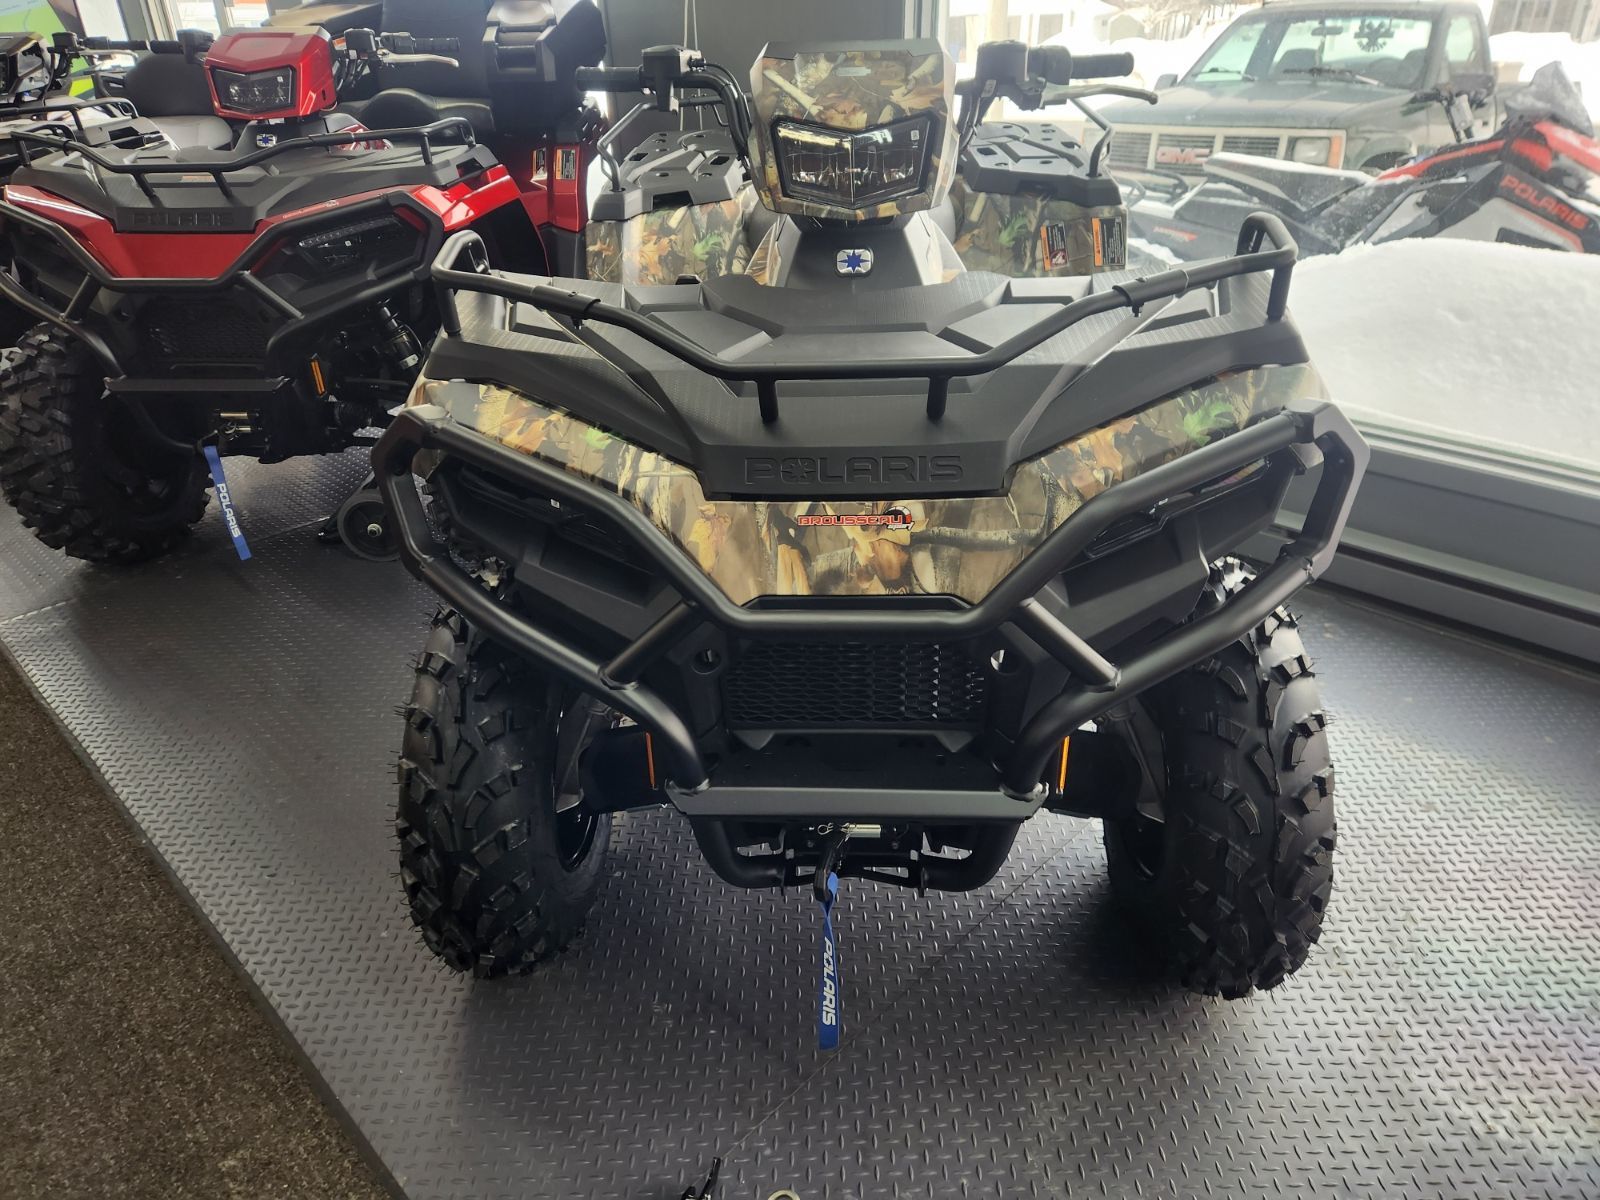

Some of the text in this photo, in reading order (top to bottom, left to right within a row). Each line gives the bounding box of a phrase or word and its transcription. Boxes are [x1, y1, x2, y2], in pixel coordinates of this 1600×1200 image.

[1156, 146, 1210, 165] GMC
[1500, 175, 1589, 230] POLARIS
[744, 456, 964, 484] POLARIS
[217, 483, 242, 538] POLARIS
[798, 515, 903, 526] BROUSSEAU
[822, 936, 837, 1026] POLARIS
